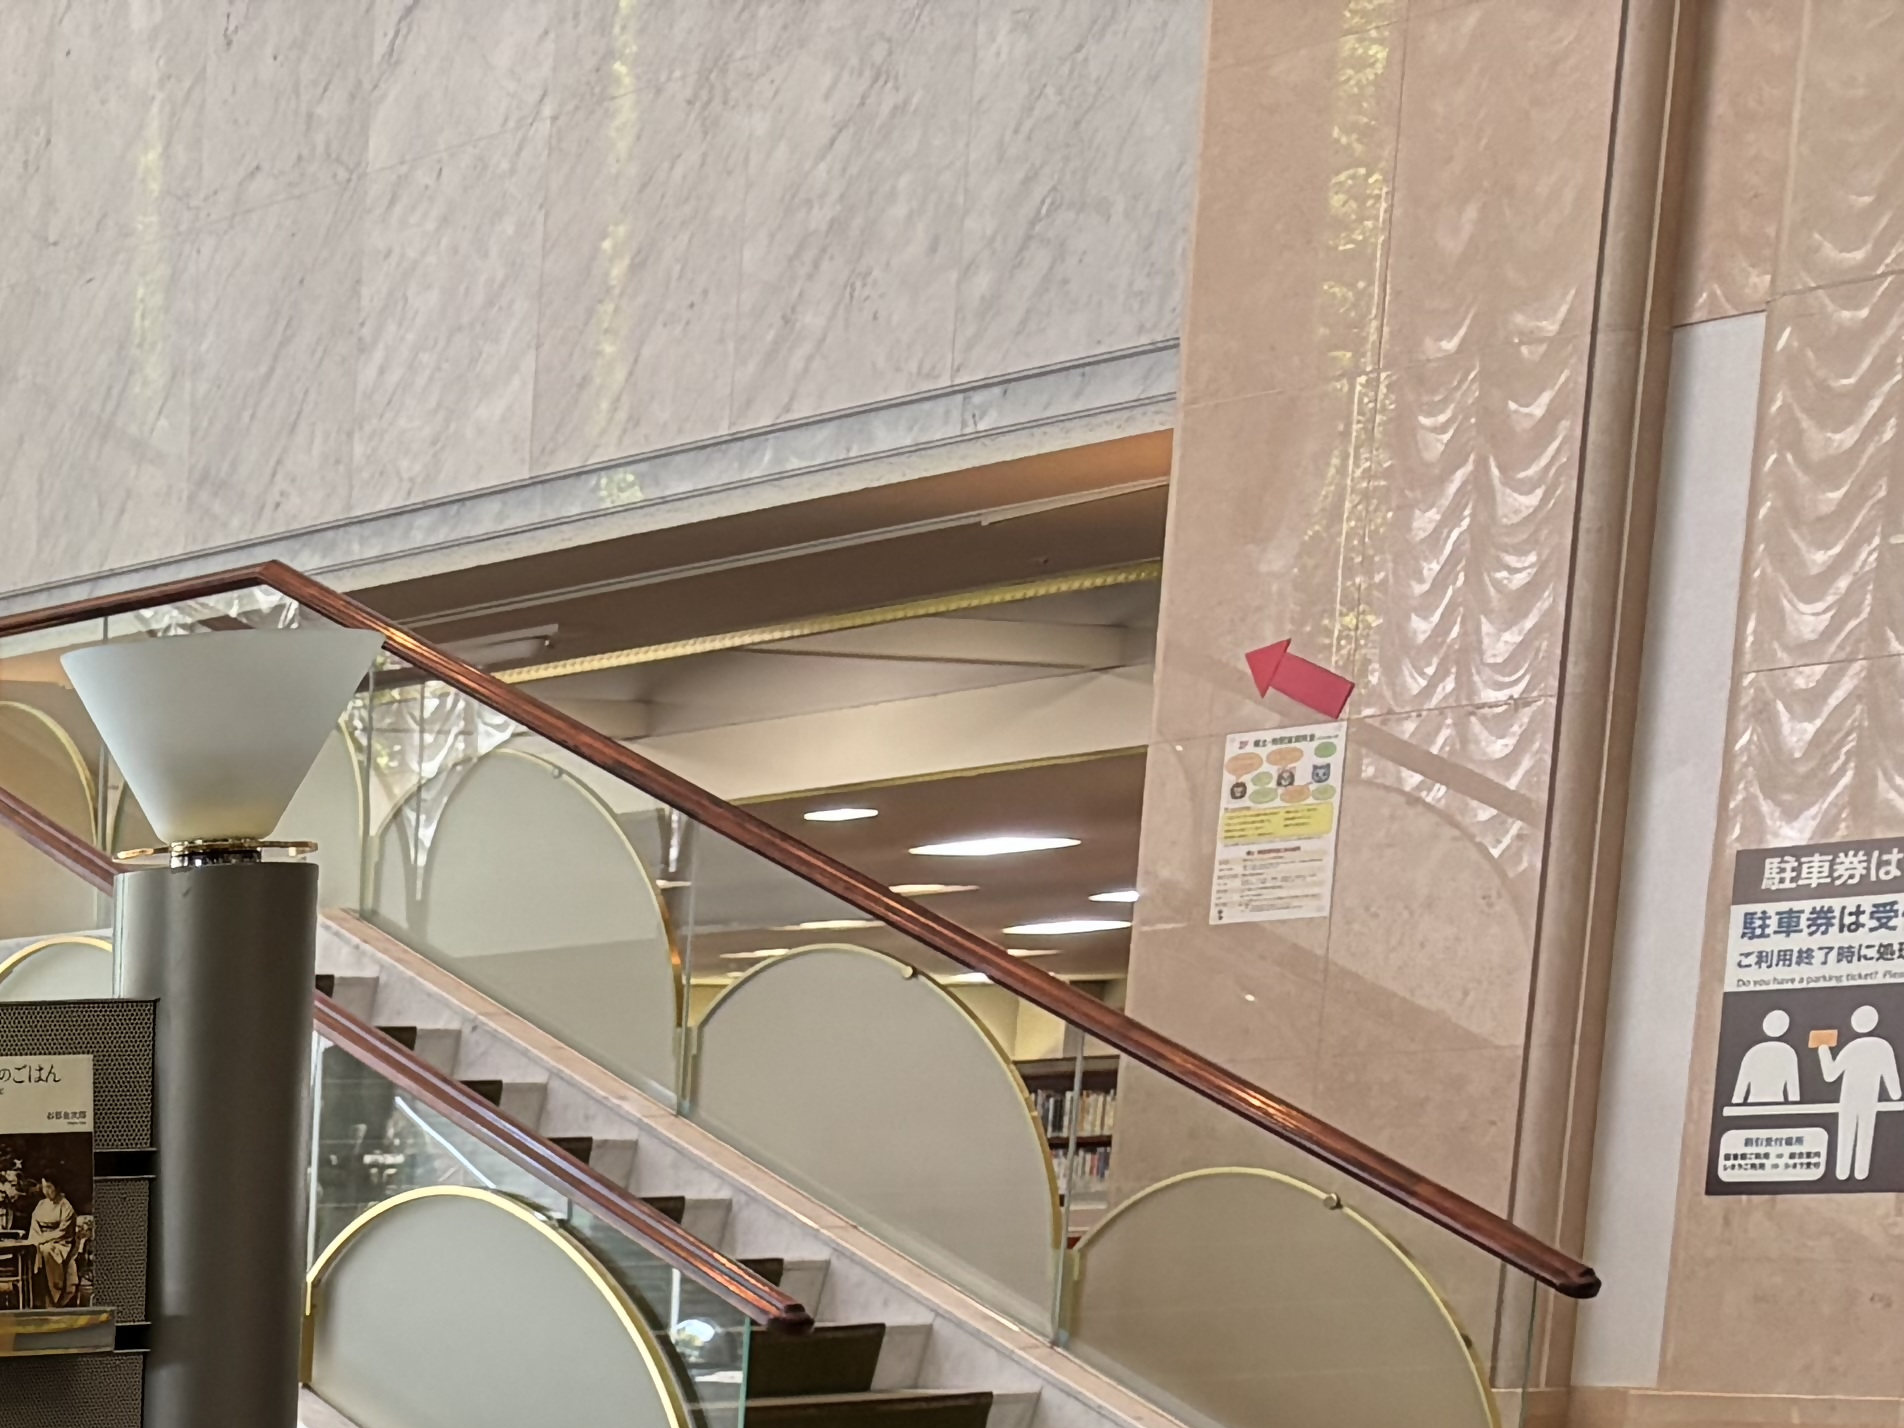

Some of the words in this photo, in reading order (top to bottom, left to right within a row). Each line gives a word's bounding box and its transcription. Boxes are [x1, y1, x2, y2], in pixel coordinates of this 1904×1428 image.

[1761, 848, 1904, 890] 駐車券は
[1741, 900, 1904, 940] 駐車券は受
